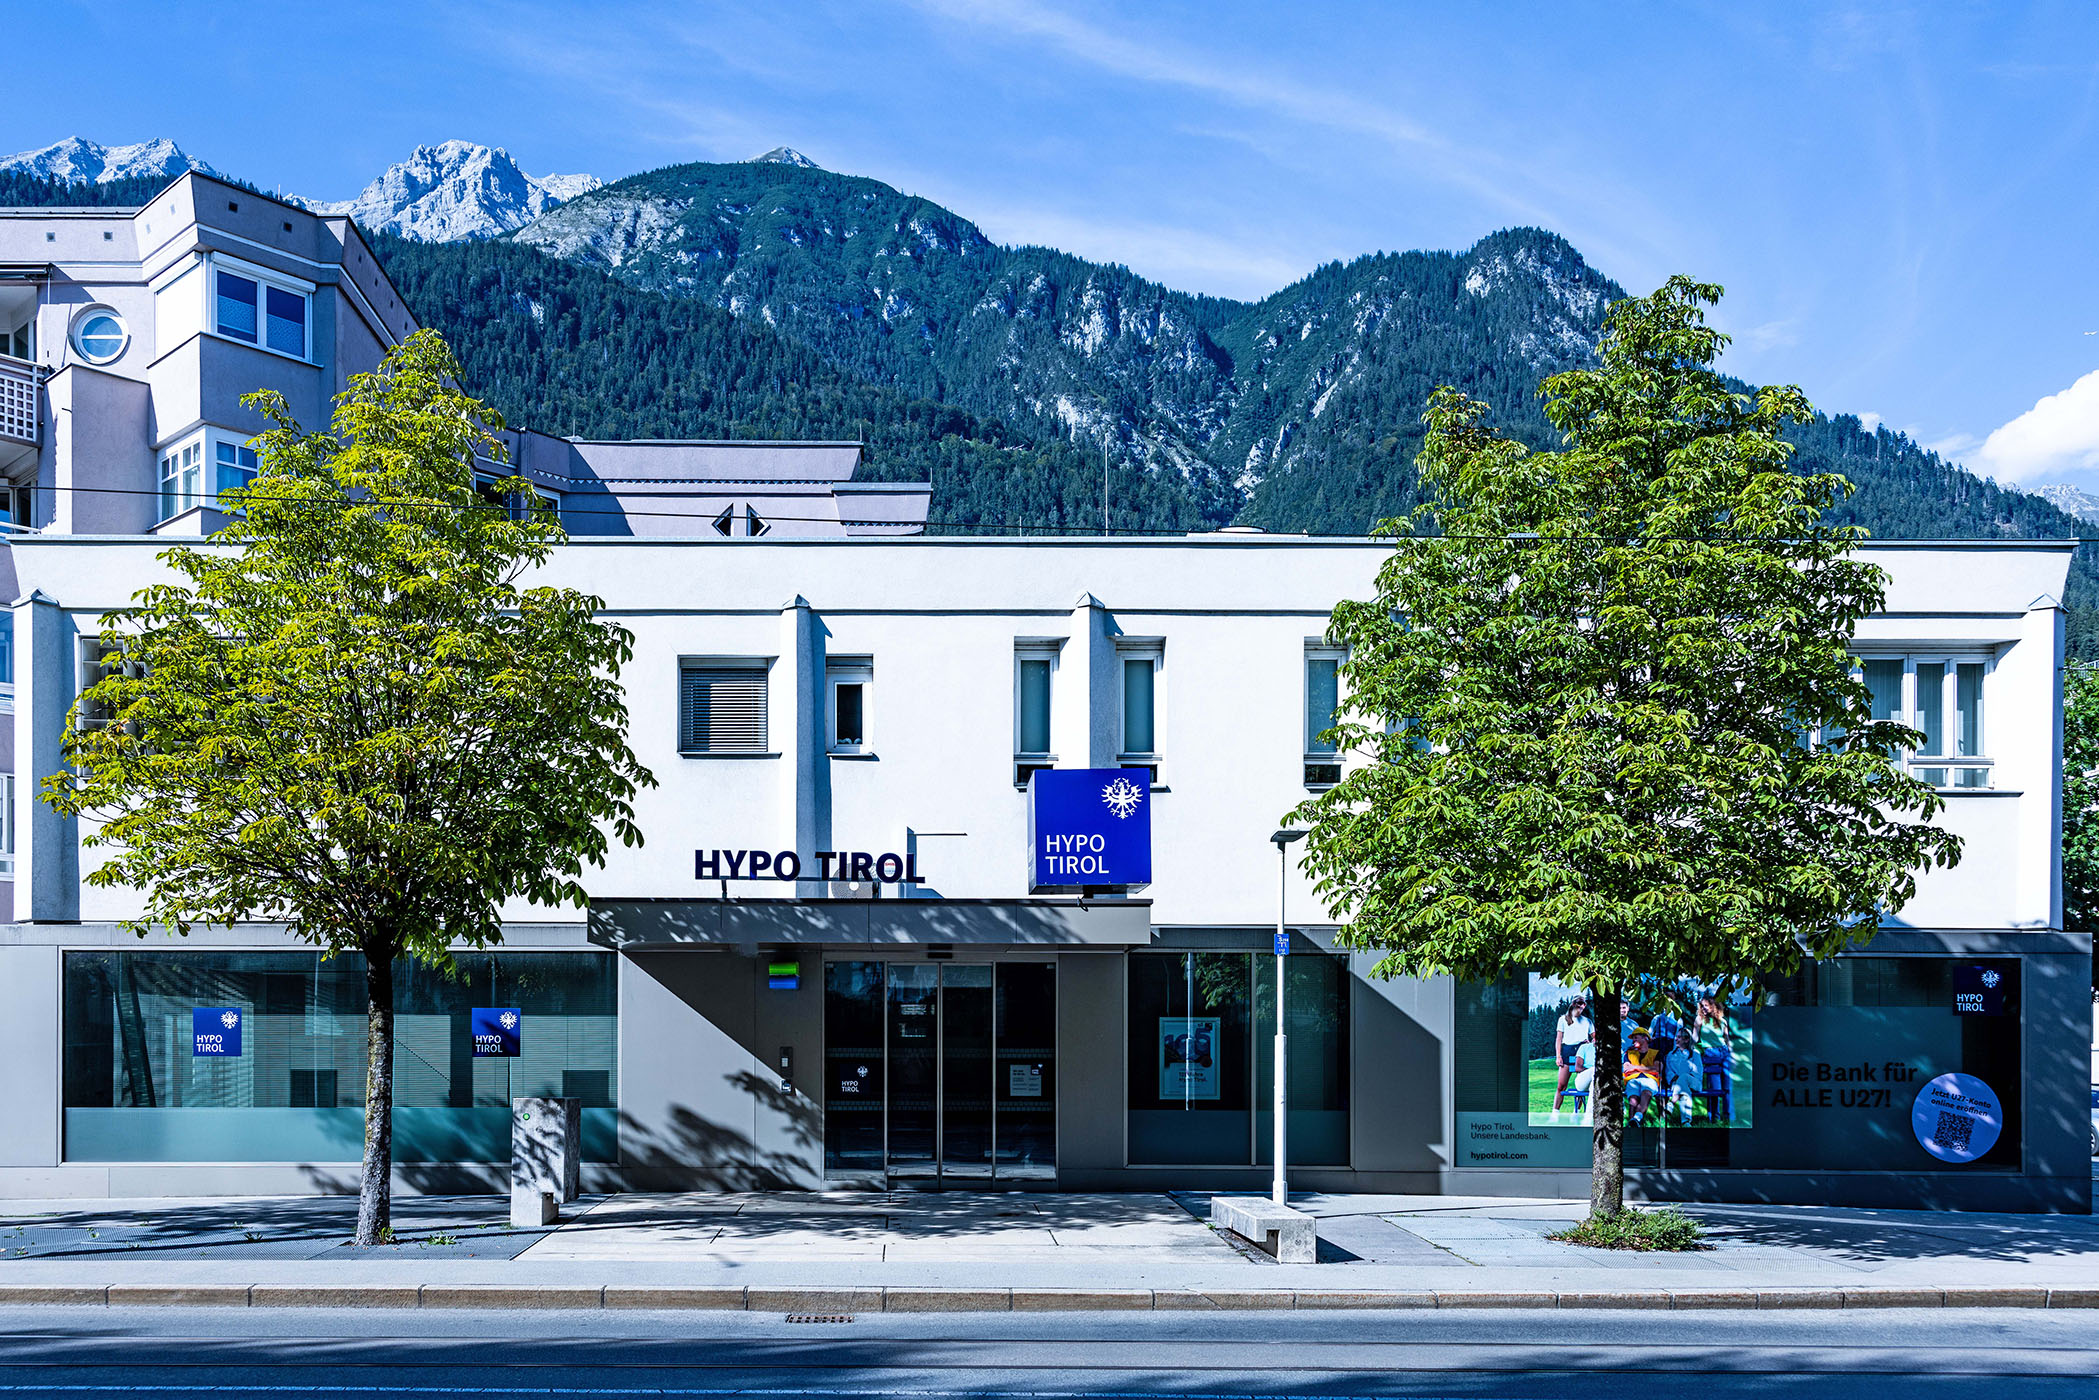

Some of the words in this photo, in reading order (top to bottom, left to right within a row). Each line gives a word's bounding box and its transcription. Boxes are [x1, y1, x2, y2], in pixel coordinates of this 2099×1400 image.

[1046, 834, 1105, 853] HYPO
[695, 849, 801, 881] HYPO
[815, 852, 926, 884] TIROL
[1045, 855, 1110, 874] TIROL
[1956, 993, 1984, 1003] HYPO
[1956, 1002, 1985, 1012] TIROL
[196, 1034, 223, 1044] HYPO
[475, 1034, 502, 1044] HYPO
[196, 1043, 225, 1053] TIROL
[475, 1043, 503, 1053] TIROL
[1772, 1061, 1809, 1082] Die
[1816, 1061, 1877, 1082] Bank
[1883, 1061, 1918, 1082] für
[1771, 1088, 1833, 1108] ALLE
[1839, 1088, 1891, 1108] U27!
[1931, 1087, 1950, 1099] Jetzt
[1931, 1098, 1955, 1109] online
[1470, 1122, 1492, 1132] Hypo
[1494, 1122, 1516, 1131] Tirol.
[1470, 1132, 1499, 1140] Unsere
[1500, 1132, 1551, 1140] Landesbank.
[1470, 1151, 1528, 1161] hypotirol.com
